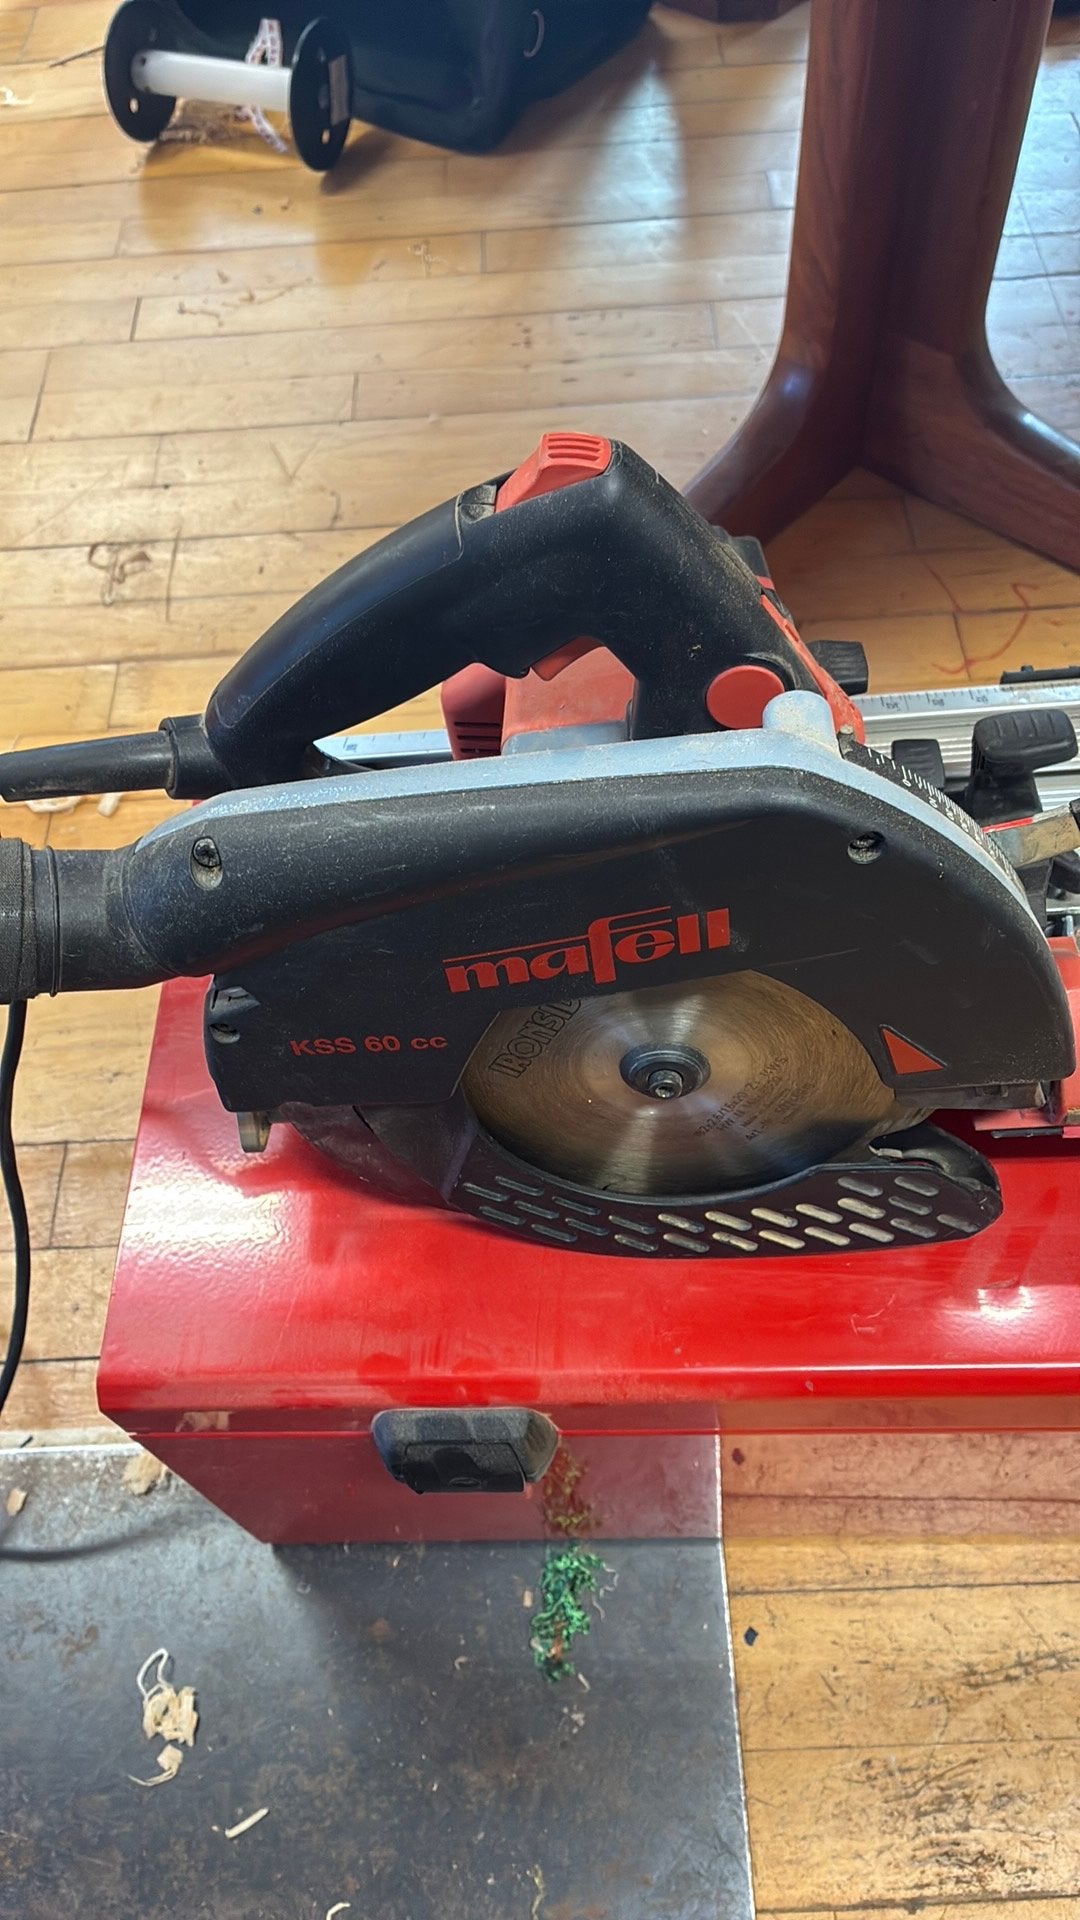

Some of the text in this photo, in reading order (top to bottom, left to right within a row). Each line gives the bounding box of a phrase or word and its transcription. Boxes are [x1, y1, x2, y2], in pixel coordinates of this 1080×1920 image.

[442, 905, 731, 993] mafell
[290, 1034, 448, 1056] KSS 60 cc
